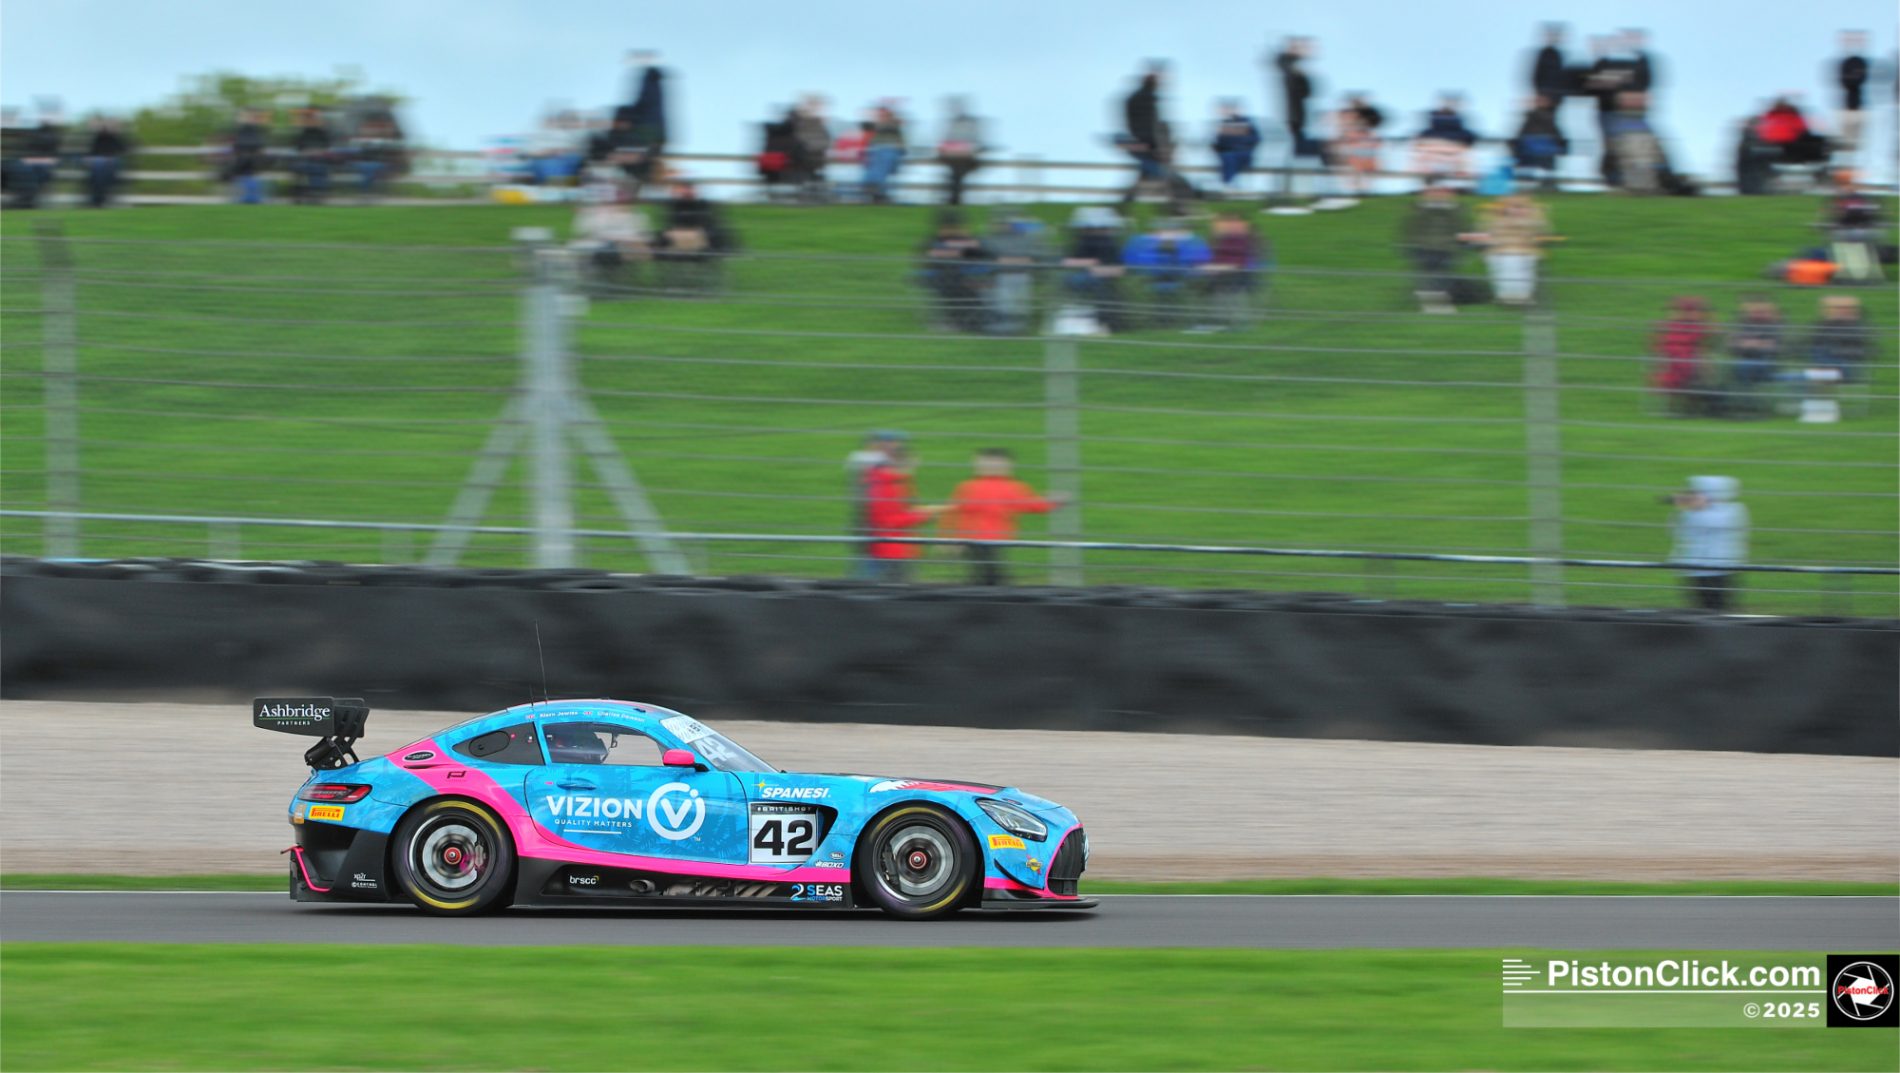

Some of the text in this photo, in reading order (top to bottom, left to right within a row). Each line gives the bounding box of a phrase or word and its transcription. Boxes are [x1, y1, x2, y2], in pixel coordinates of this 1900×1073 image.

[259, 704, 330, 721] Ashbridge
[311, 807, 341, 818] PIRELLI
[546, 796, 642, 819] VIZION
[593, 820, 633, 828] MATTERS
[754, 820, 813, 856] 42
[569, 875, 597, 885] brscc
[806, 885, 843, 896] SEAS
